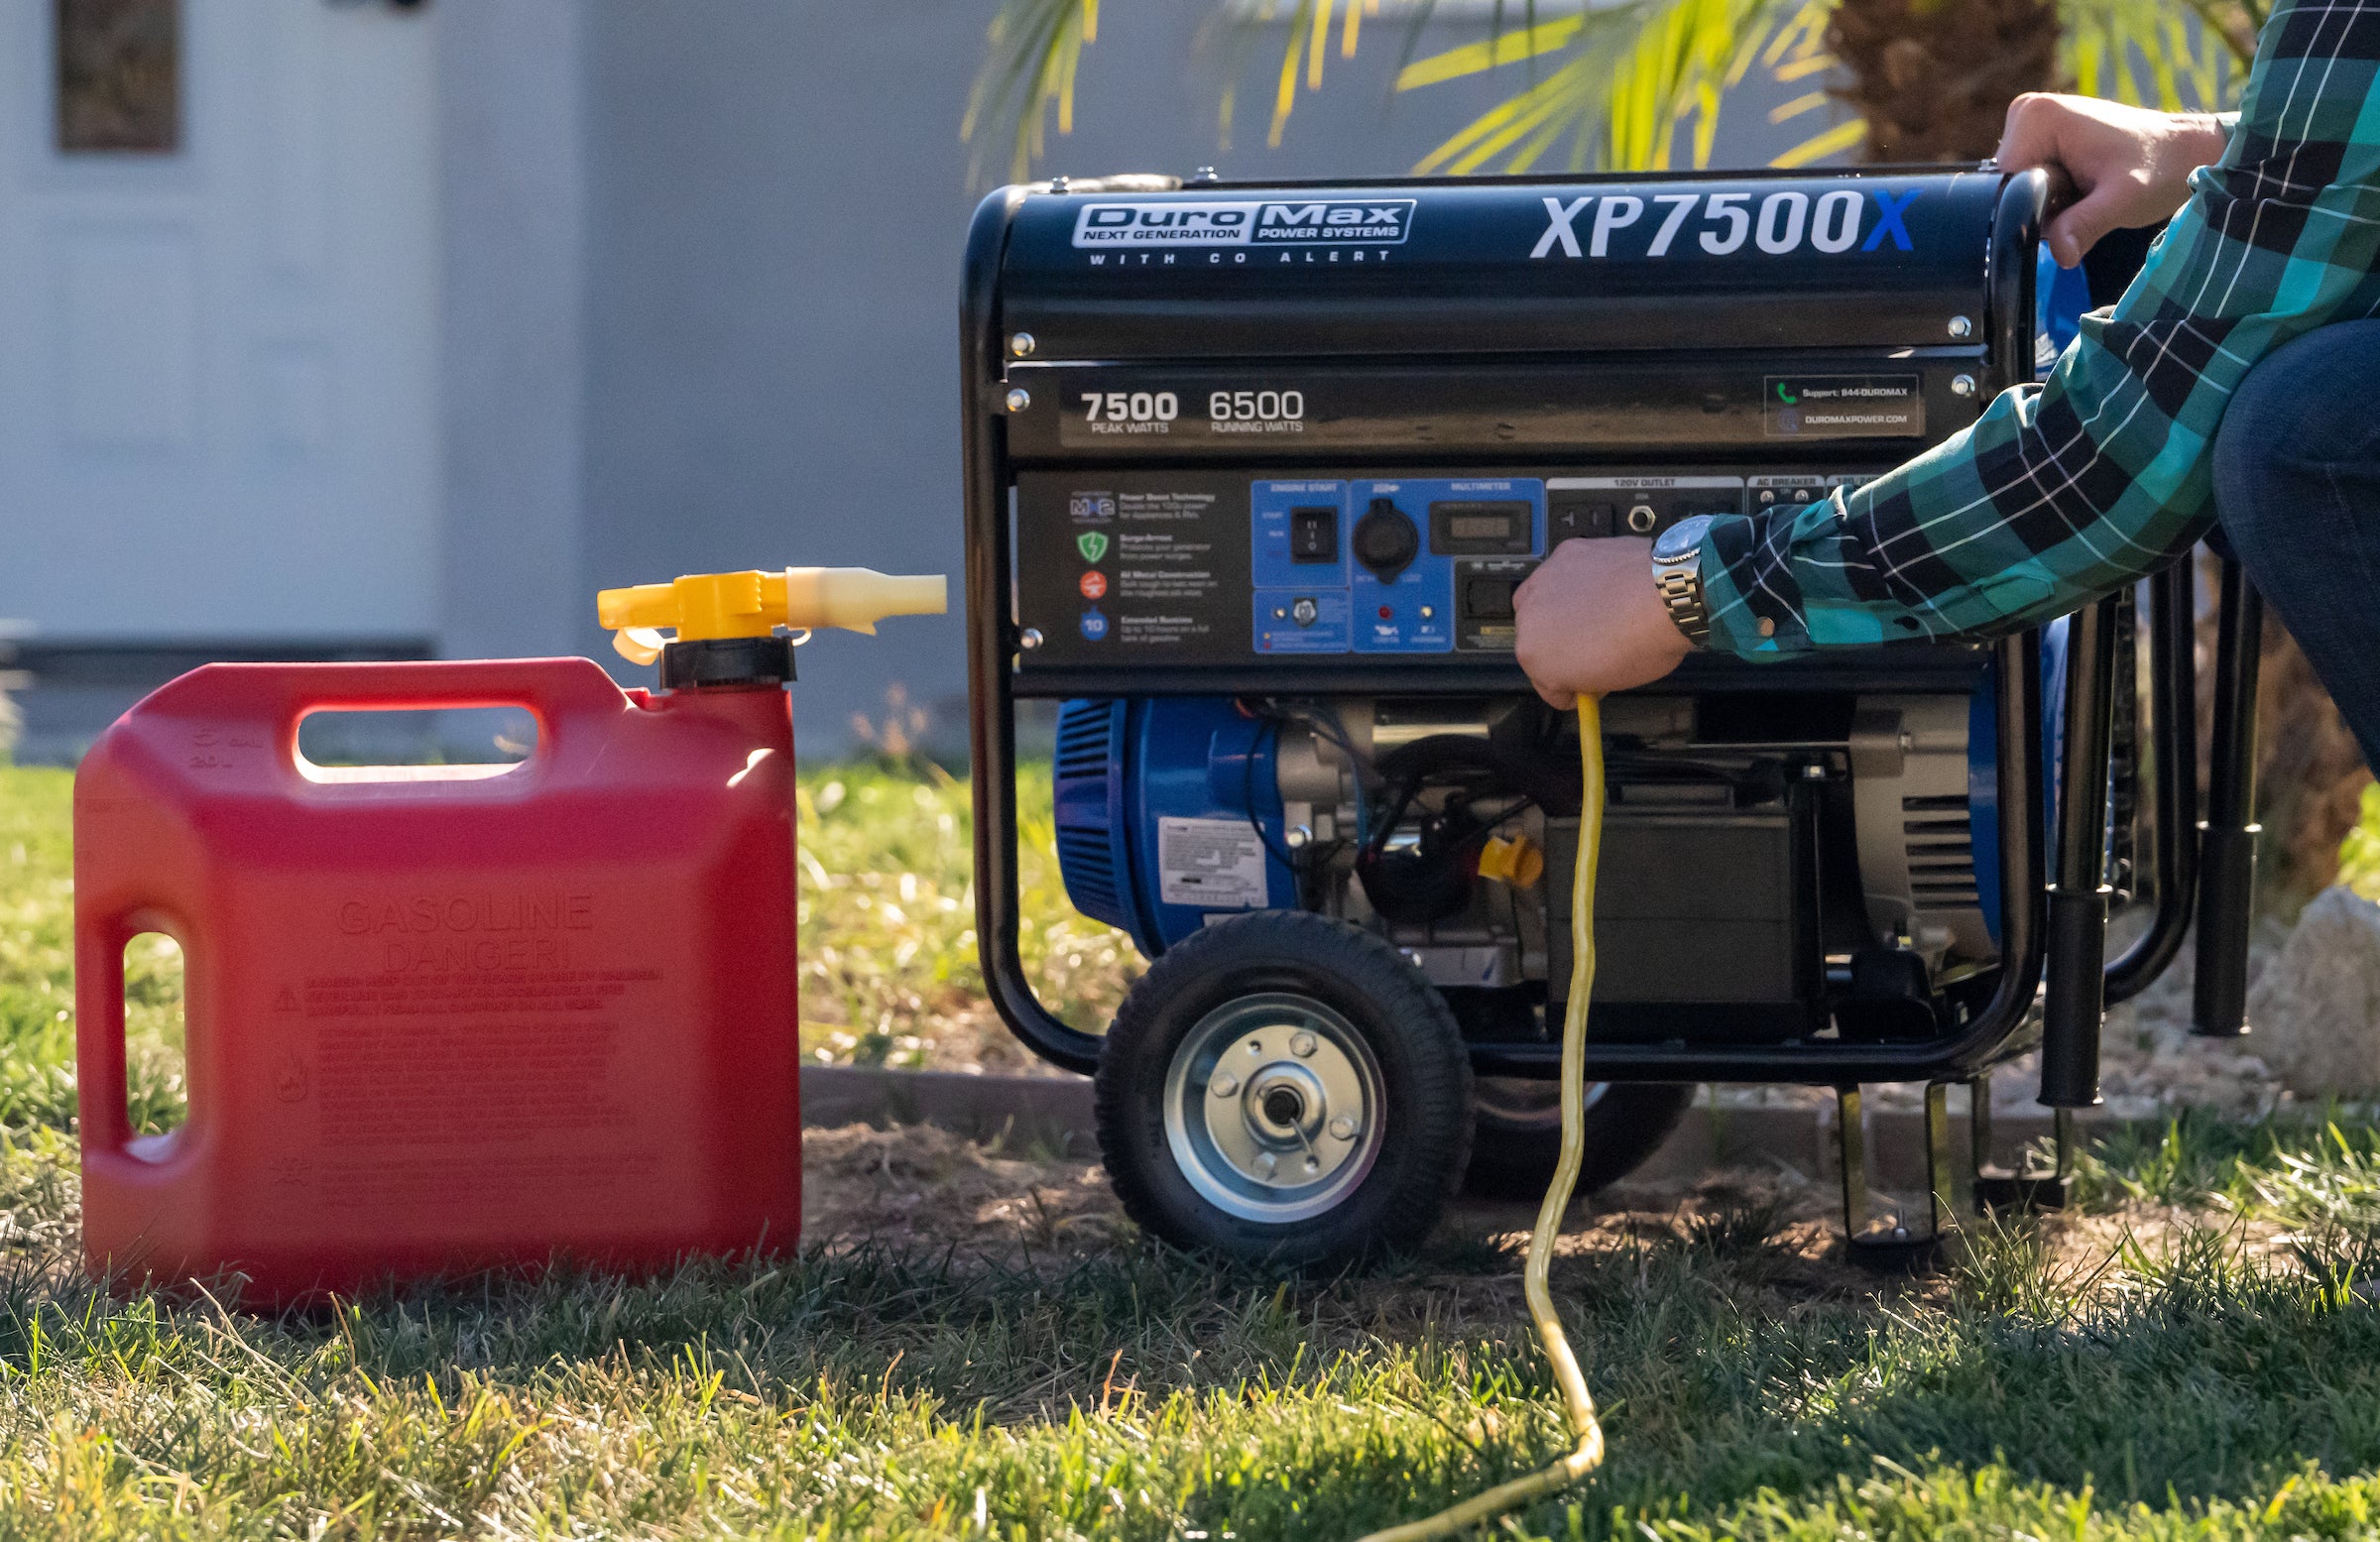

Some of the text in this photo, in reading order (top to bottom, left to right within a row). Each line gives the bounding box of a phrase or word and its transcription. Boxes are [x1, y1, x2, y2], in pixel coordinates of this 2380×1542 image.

[1528, 187, 1925, 259] XP7500X
[1083, 228, 1241, 240] NEXT GENERATION
[1257, 225, 1400, 239] POWER SYSTEMS
[1090, 250, 1389, 266] WITH CO ALERT
[1802, 388, 1840, 399] Support:
[1080, 392, 1179, 421] 7500
[1209, 390, 1304, 421] 6500
[1805, 415, 1908, 424] DUROMAXPOWER.COM
[1092, 421, 1169, 434] PEAK WATTS
[1210, 420, 1304, 433] RUNNING WATTS
[1613, 477, 1676, 487] 120V OUTLET
[1771, 477, 1817, 486] BREAKER
[1084, 619, 1104, 632] 10
[334, 891, 594, 936] GASOLINE
[383, 936, 571, 974] DANGER!
